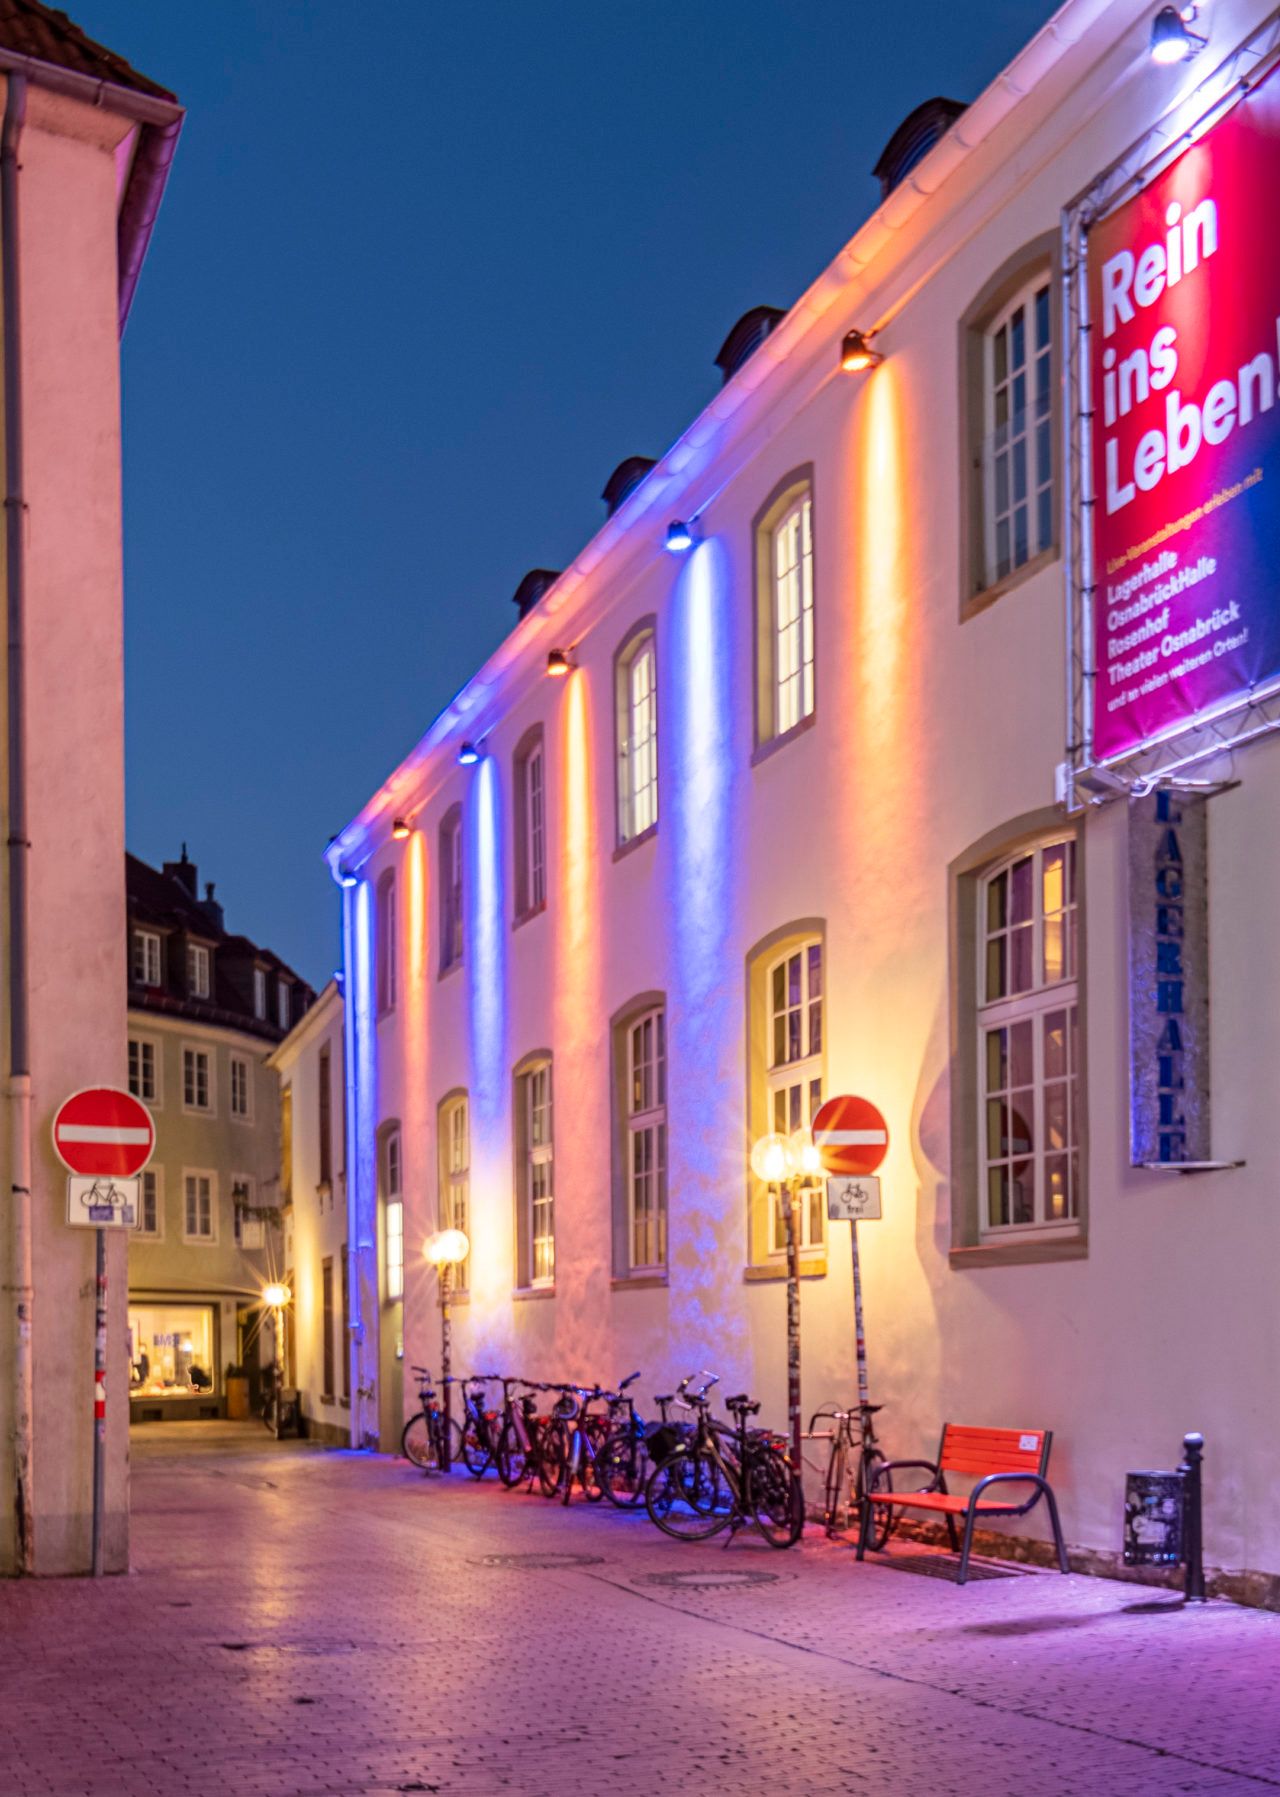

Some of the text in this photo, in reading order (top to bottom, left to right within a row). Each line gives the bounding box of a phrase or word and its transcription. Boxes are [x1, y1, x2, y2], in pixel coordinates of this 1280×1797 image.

[1102, 199, 1217, 338] Rein
[1103, 326, 1178, 428] ins
[1107, 550, 1179, 604] Lagerhalle
[1107, 555, 1217, 631] OsnabrückHalle
[1107, 607, 1171, 659] Rosenhof
[1107, 600, 1241, 686] Theater Osnabrück
[1107, 627, 1250, 712] und an vielen weiteren Orten!
